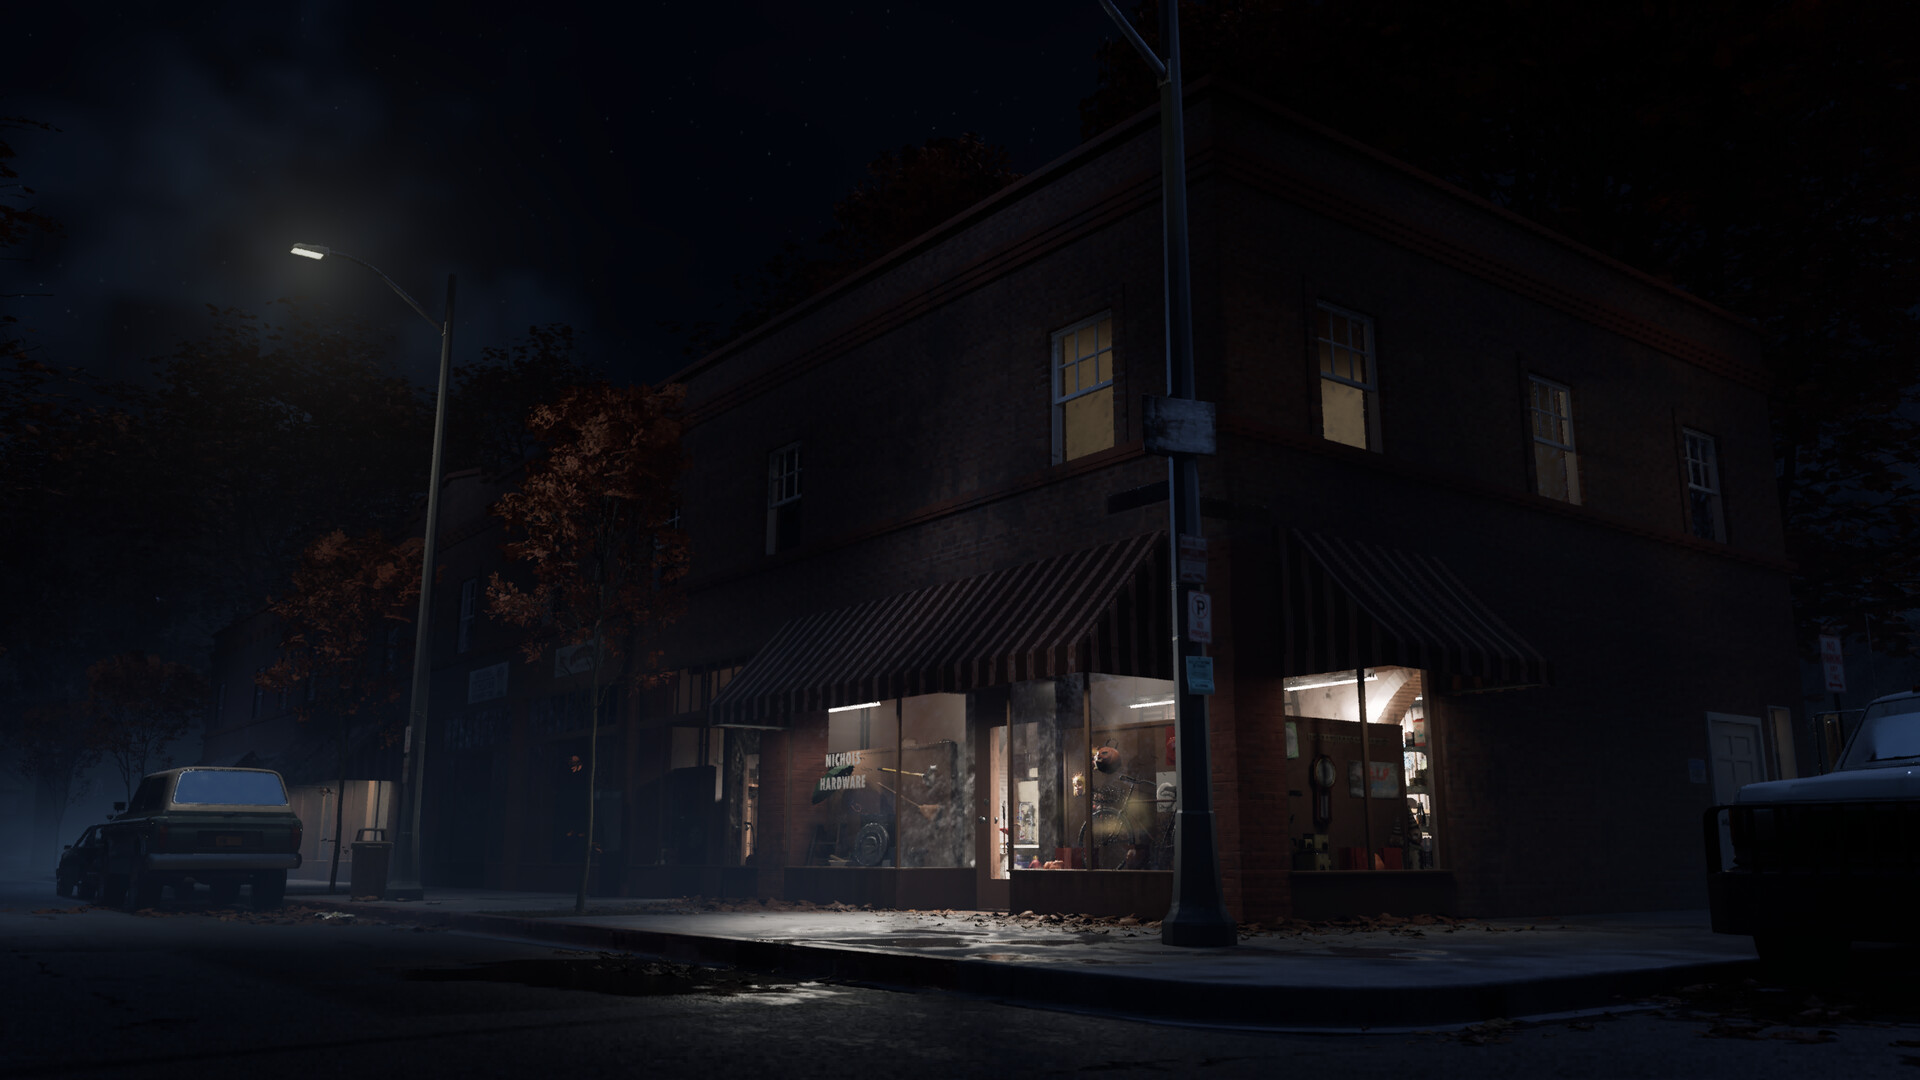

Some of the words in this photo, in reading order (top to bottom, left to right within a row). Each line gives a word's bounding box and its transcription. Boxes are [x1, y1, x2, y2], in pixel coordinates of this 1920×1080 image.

[1196, 600, 1206, 615] P
[1826, 641, 1836, 652] NO
[825, 751, 861, 768] NICHOLS
[820, 774, 866, 791] HARDWARE
